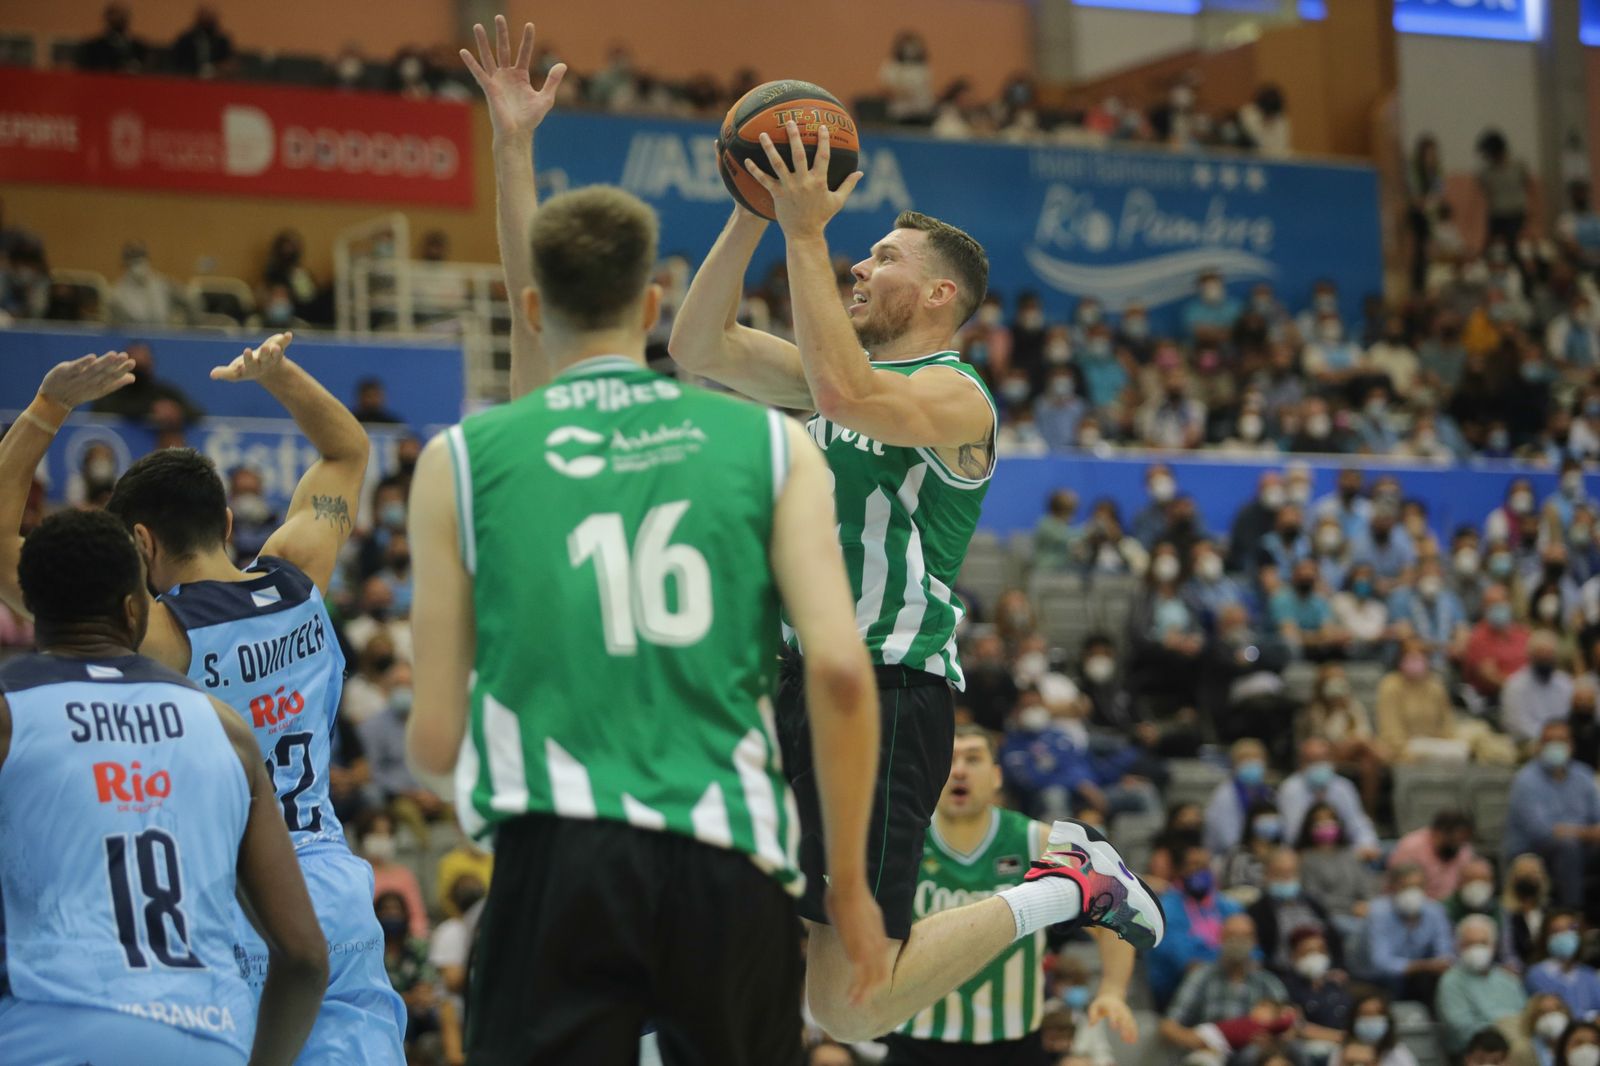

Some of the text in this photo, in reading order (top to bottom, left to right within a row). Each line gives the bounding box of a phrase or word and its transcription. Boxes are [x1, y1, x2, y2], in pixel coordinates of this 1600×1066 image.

[545, 378, 682, 412] SPIRES
[566, 499, 715, 657] 16
[204, 613, 325, 689] S. QUINTELA
[65, 701, 184, 744] SAKHO
[104, 827, 208, 970] 18
